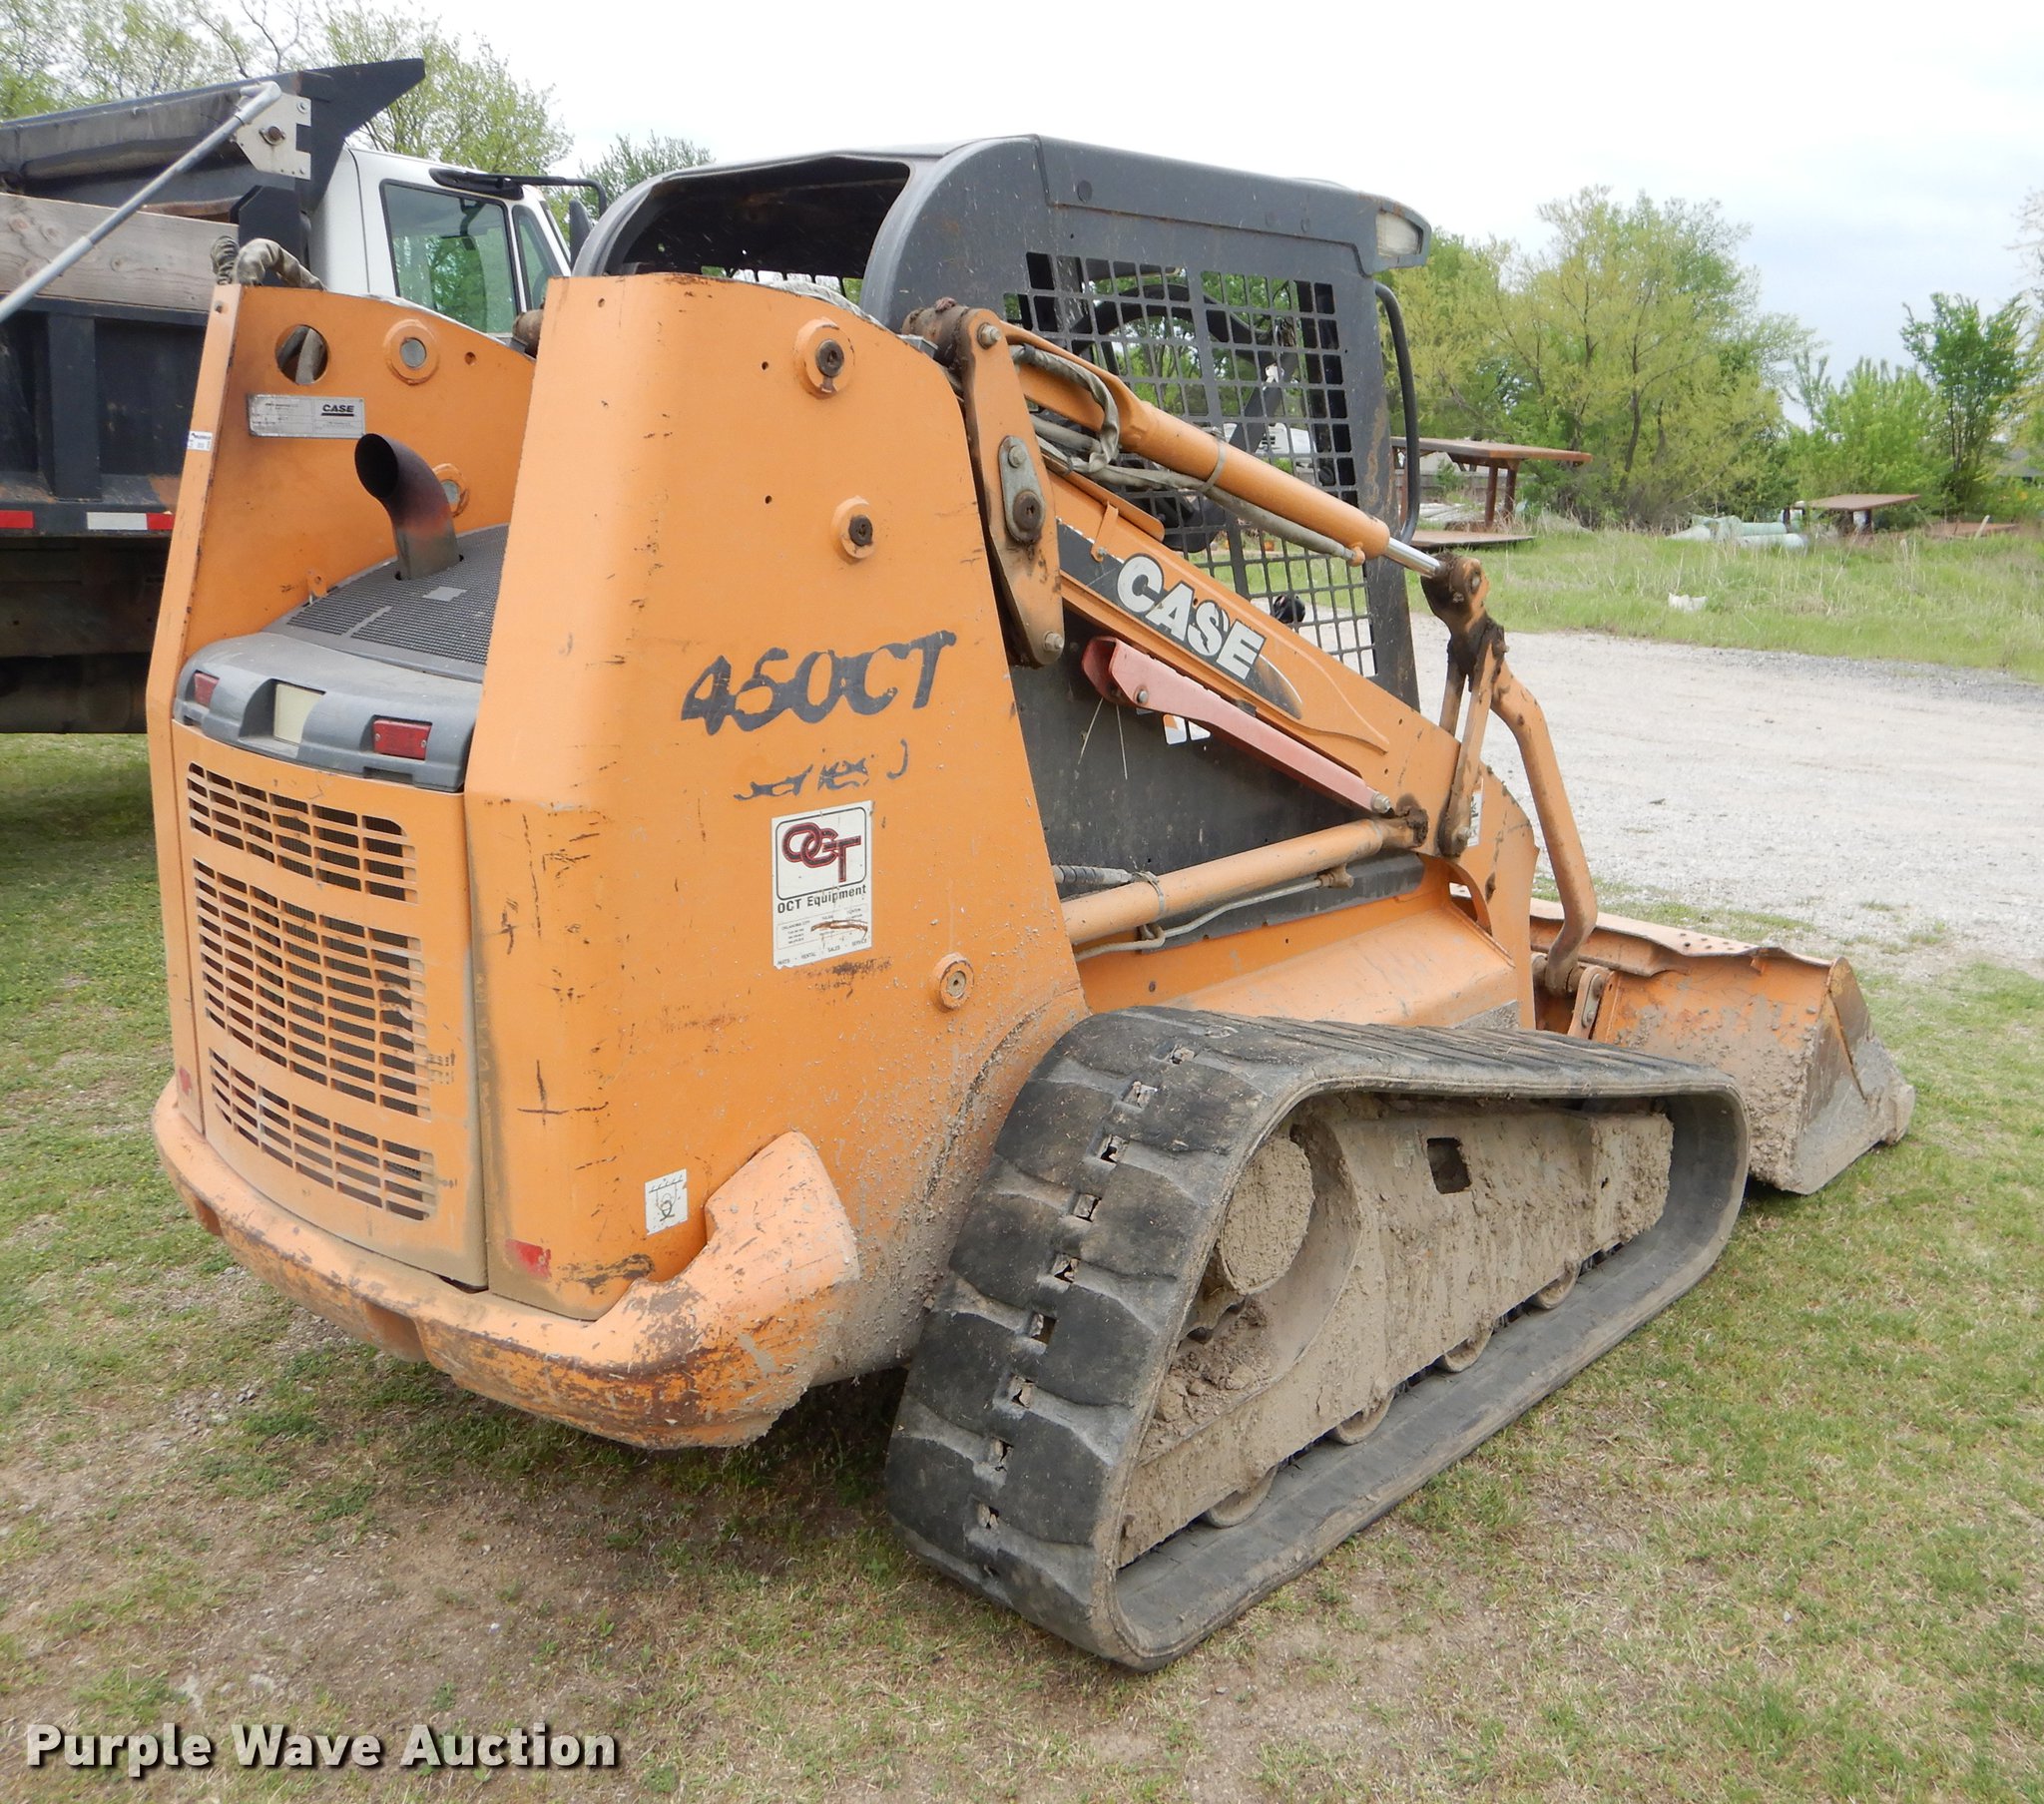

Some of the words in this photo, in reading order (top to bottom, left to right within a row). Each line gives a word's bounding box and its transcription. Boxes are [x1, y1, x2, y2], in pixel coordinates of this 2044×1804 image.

[322, 404, 354, 413] CASE
[1117, 554, 1268, 680] CASE
[777, 899, 802, 914] OCT
[806, 885, 866, 907] Equipment
